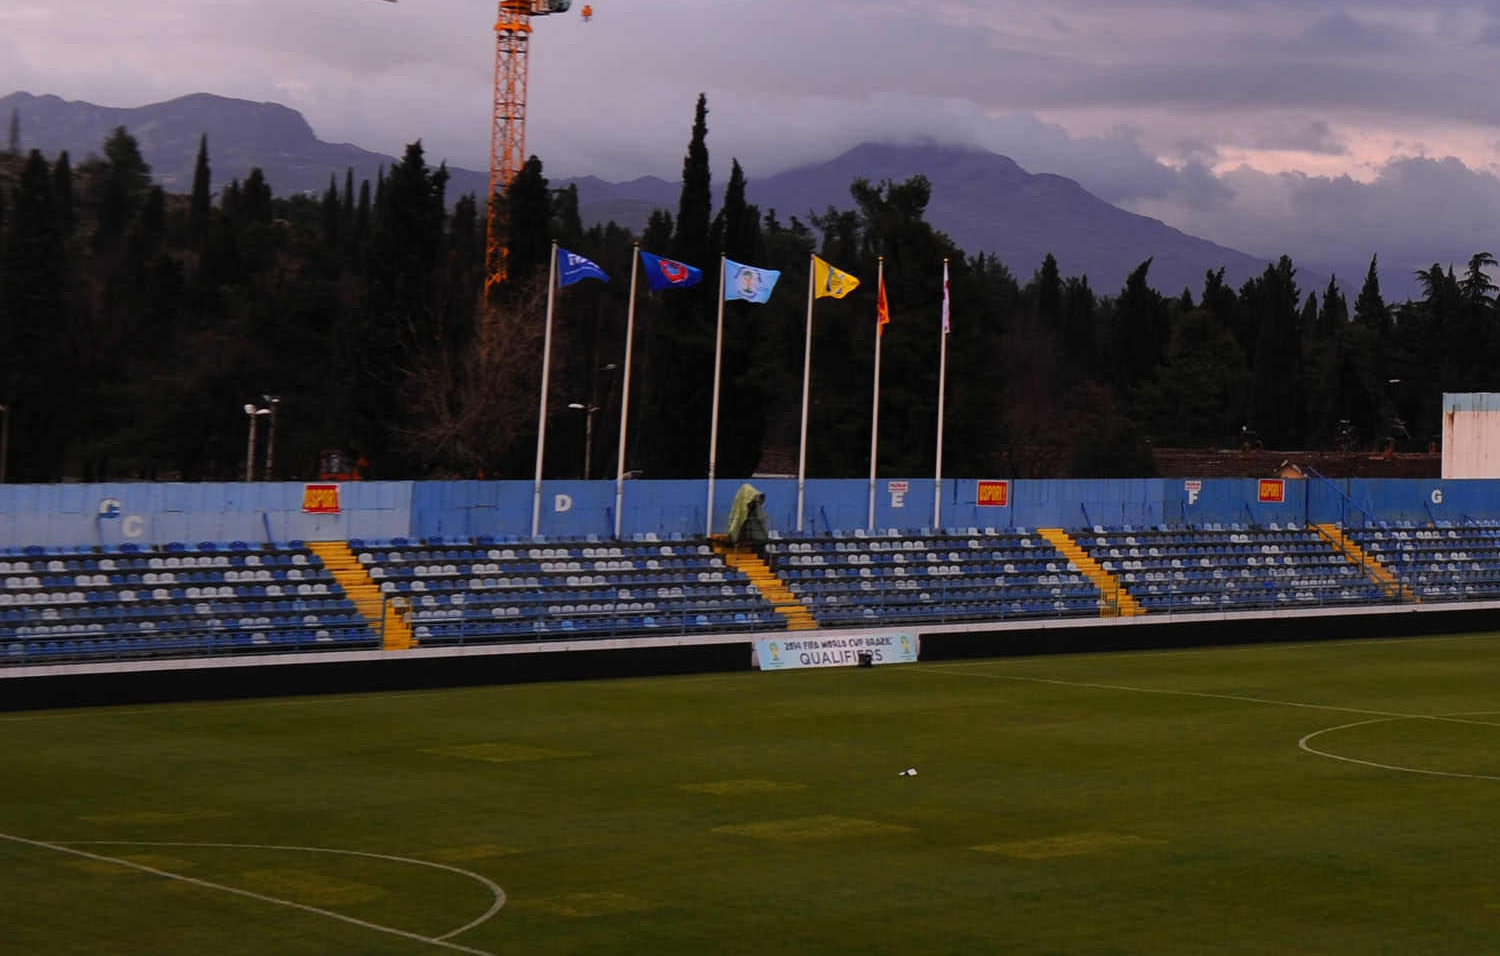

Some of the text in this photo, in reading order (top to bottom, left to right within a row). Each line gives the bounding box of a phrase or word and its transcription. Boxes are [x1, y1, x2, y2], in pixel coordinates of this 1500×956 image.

[554, 494, 573, 512] D
[892, 492, 904, 508] E
[1189, 490, 1199, 505] F
[1431, 486, 1442, 504] G
[122, 515, 144, 538] C
[784, 642, 801, 651] 2014
[803, 641, 820, 650] FIFA
[820, 639, 847, 649] WORLD
[848, 638, 863, 647] CUP
